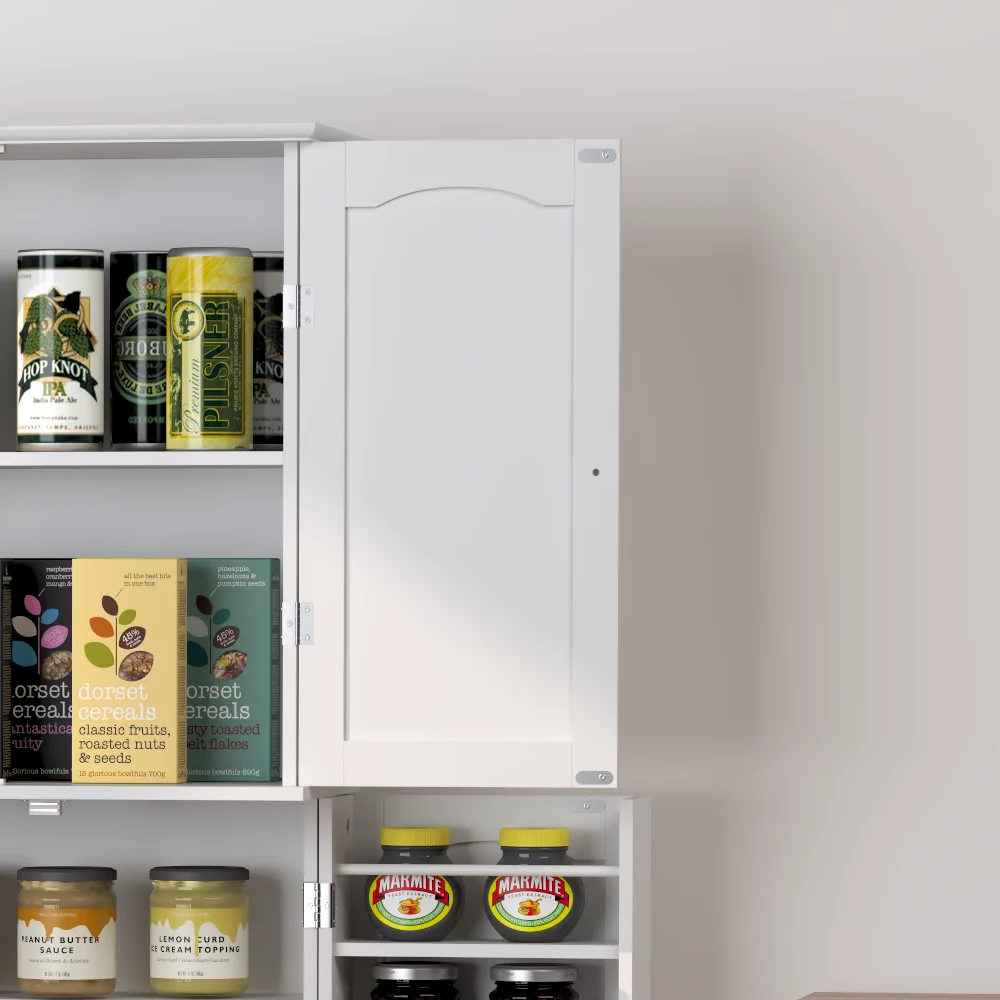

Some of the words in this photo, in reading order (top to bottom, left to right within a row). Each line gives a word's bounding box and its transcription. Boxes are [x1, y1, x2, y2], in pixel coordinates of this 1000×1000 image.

[23, 360, 48, 383] HOP
[51, 360, 88, 382] KNOT
[202, 301, 230, 429] PILSNER
[42, 382, 66, 396] IPA
[182, 358, 200, 434] Premium
[217, 566, 250, 574] pineapple,
[78, 683, 147, 700] dorset
[78, 702, 157, 720] cereals
[79, 724, 125, 735] classic
[129, 723, 171, 738] fruits,
[211, 724, 260, 735] toasted
[79, 738, 131, 750] roasted
[134, 739, 166, 750] nuts
[209, 738, 249, 750] flakes
[94, 752, 132, 764] seeds
[379, 875, 441, 894] MARMITE
[499, 876, 561, 895] MARMITE
[21, 936, 54, 944] PEANUT
[59, 936, 100, 944] BUTTER
[40, 946, 74, 954] SAUCE
